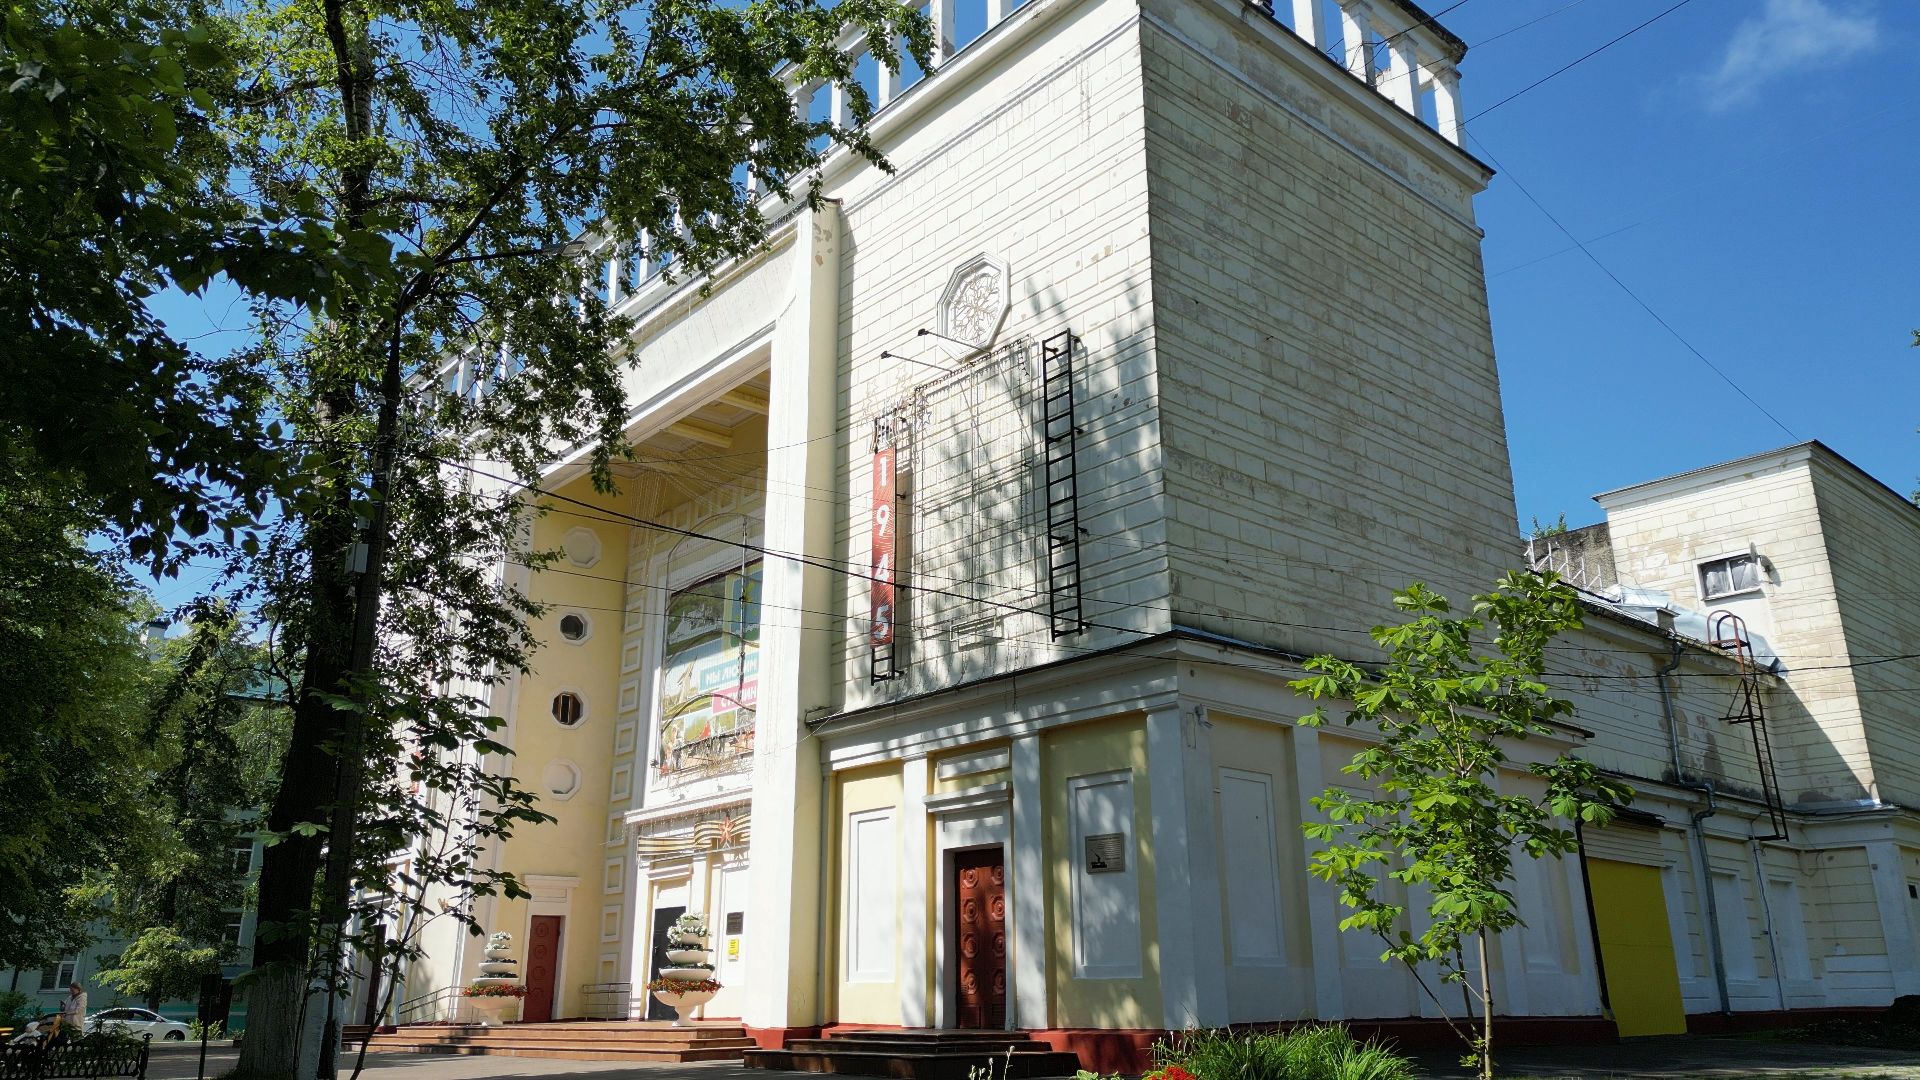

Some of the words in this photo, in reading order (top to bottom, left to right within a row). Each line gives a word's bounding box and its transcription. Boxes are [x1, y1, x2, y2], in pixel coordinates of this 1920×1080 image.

[875, 456, 890, 640] 1945
[705, 670, 720, 687] МЫ
[721, 659, 757, 680] ЛЮИМ
